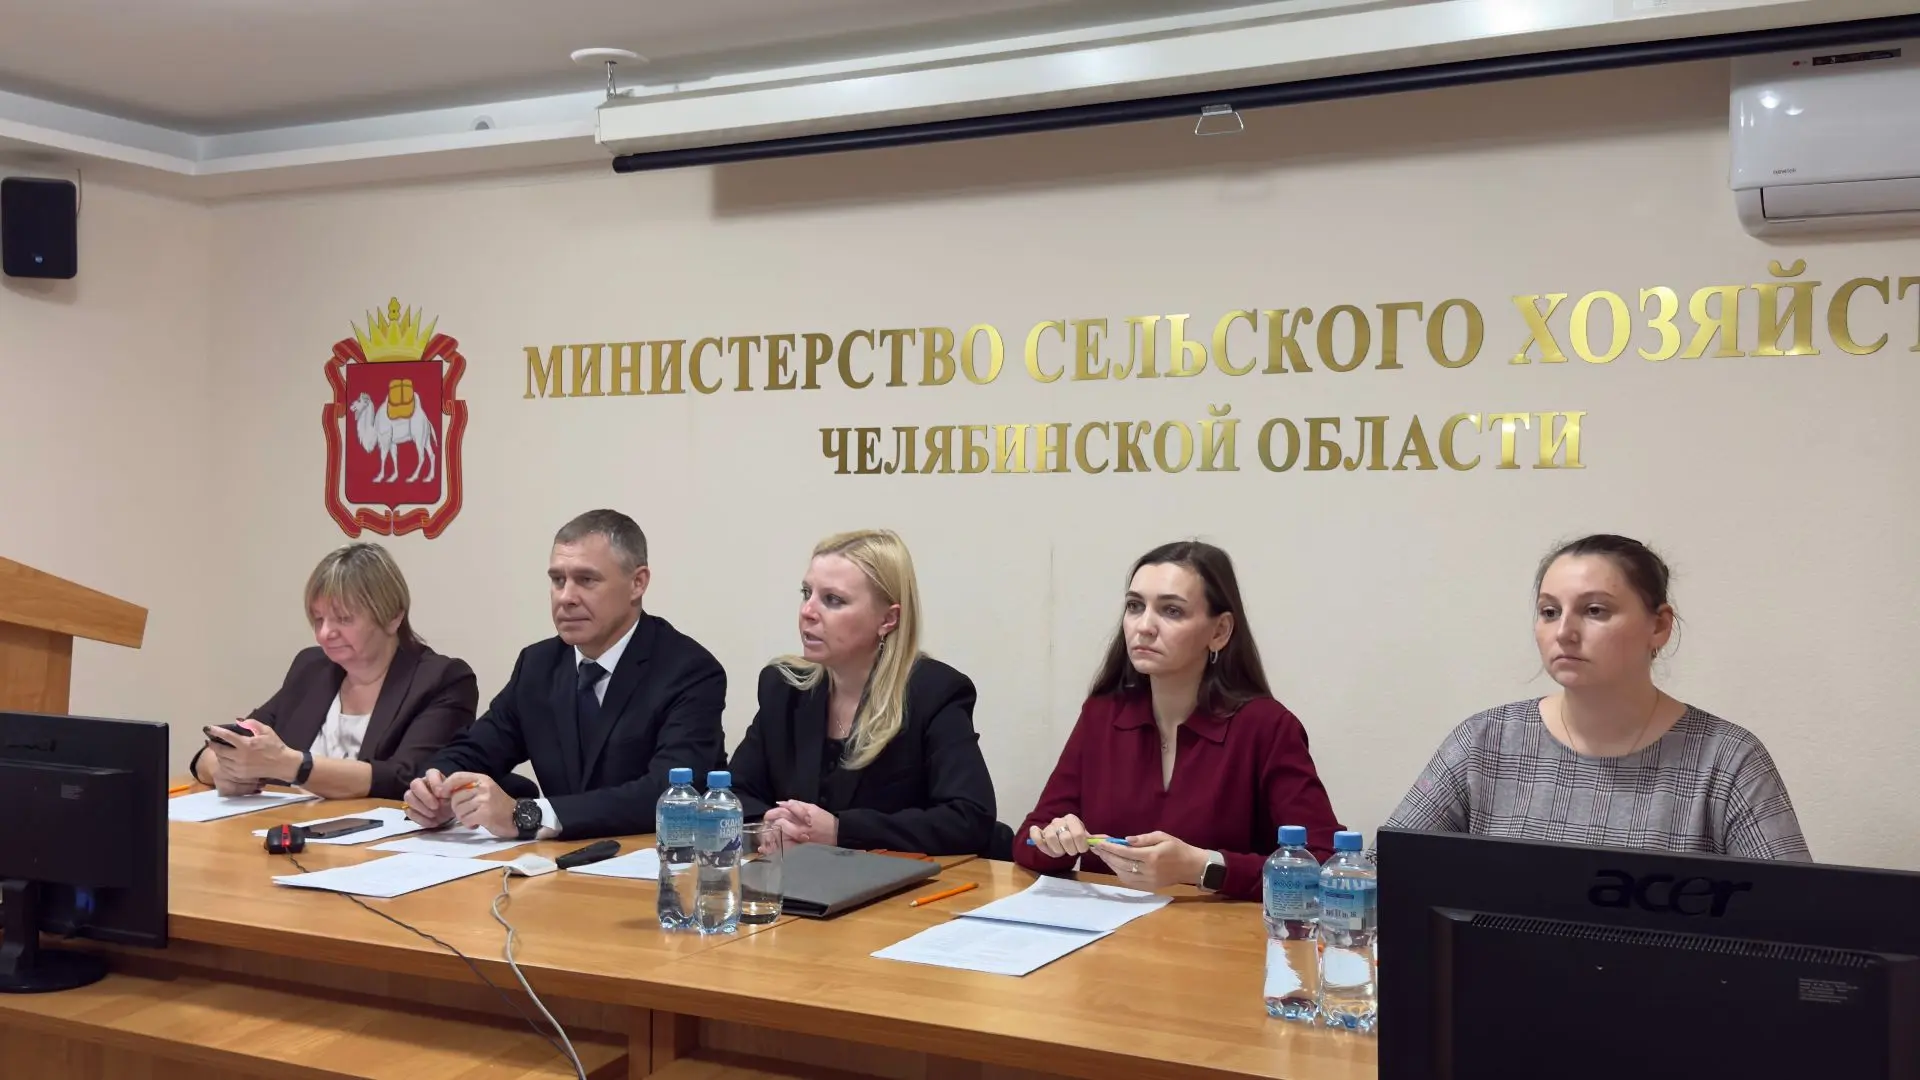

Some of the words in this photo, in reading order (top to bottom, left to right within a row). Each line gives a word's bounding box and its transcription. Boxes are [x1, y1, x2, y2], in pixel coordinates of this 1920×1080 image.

[522, 322, 1004, 399] МИНИСТЕРСТВО
[1024, 298, 1484, 384] СЕЛЬСКОГО
[819, 403, 1241, 475] ЧЕЛЯБИНСКОЙ
[1257, 411, 1587, 473] ОБЛАСТИ
[1587, 868, 1753, 917] acer
